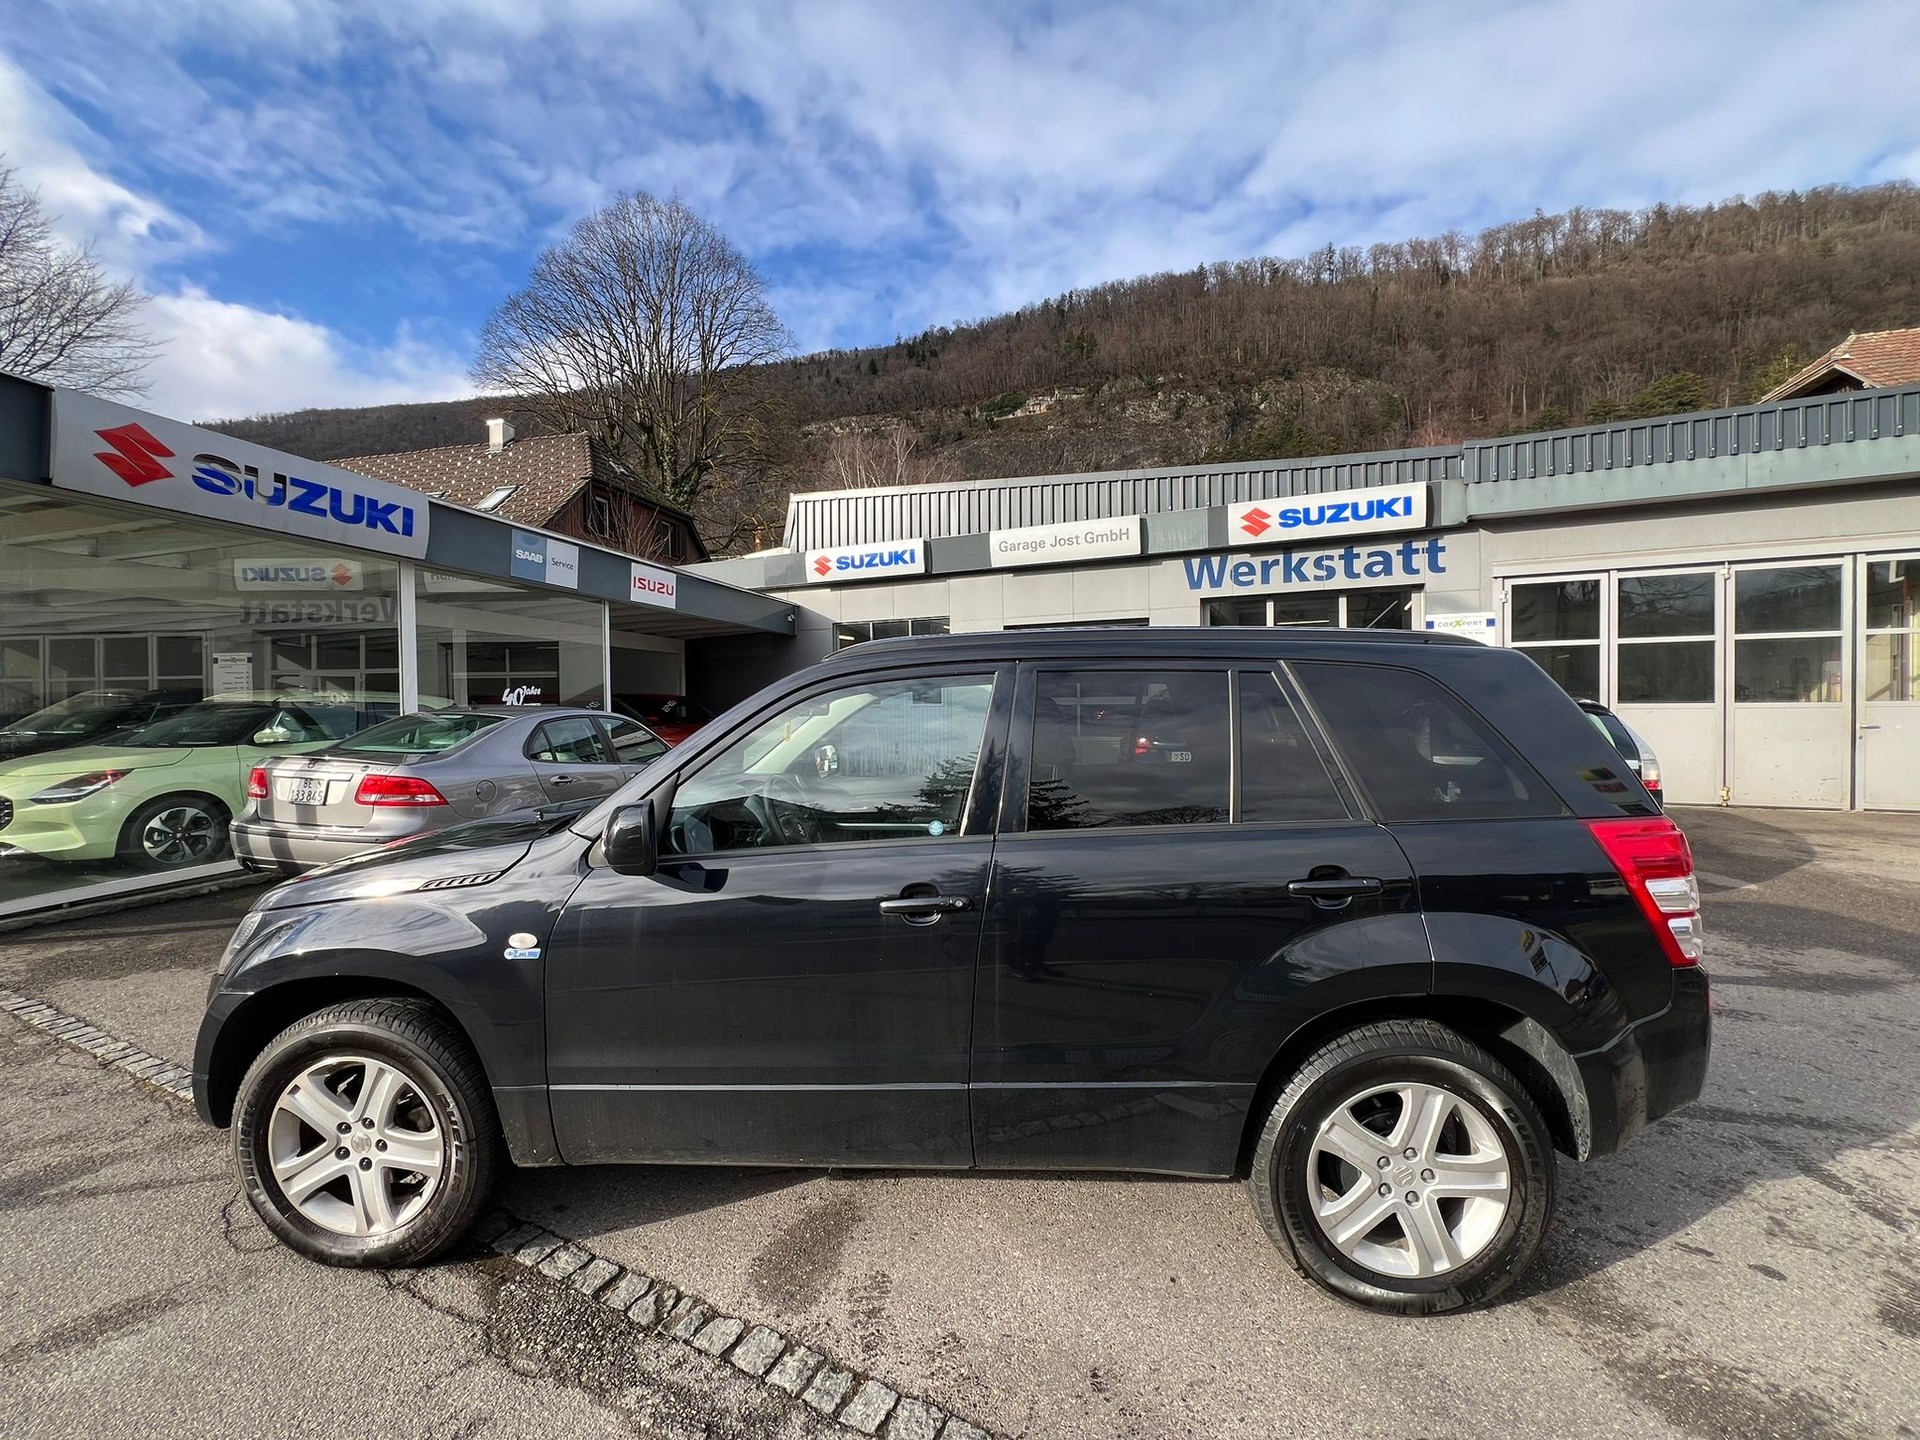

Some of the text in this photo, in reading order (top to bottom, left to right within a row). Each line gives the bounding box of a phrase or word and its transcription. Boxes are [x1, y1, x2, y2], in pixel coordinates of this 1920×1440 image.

[191, 453, 414, 537] SUZUKI
[1278, 496, 1412, 528] SUZUKI
[998, 527, 1130, 555] Garage Jost GmbH
[515, 549, 543, 564] SAAB
[551, 557, 574, 571] Service
[836, 548, 916, 571] SUZUKI
[1183, 538, 1447, 590] Werkstatt
[633, 576, 674, 597] ISUZU
[502, 688, 523, 706] 40
